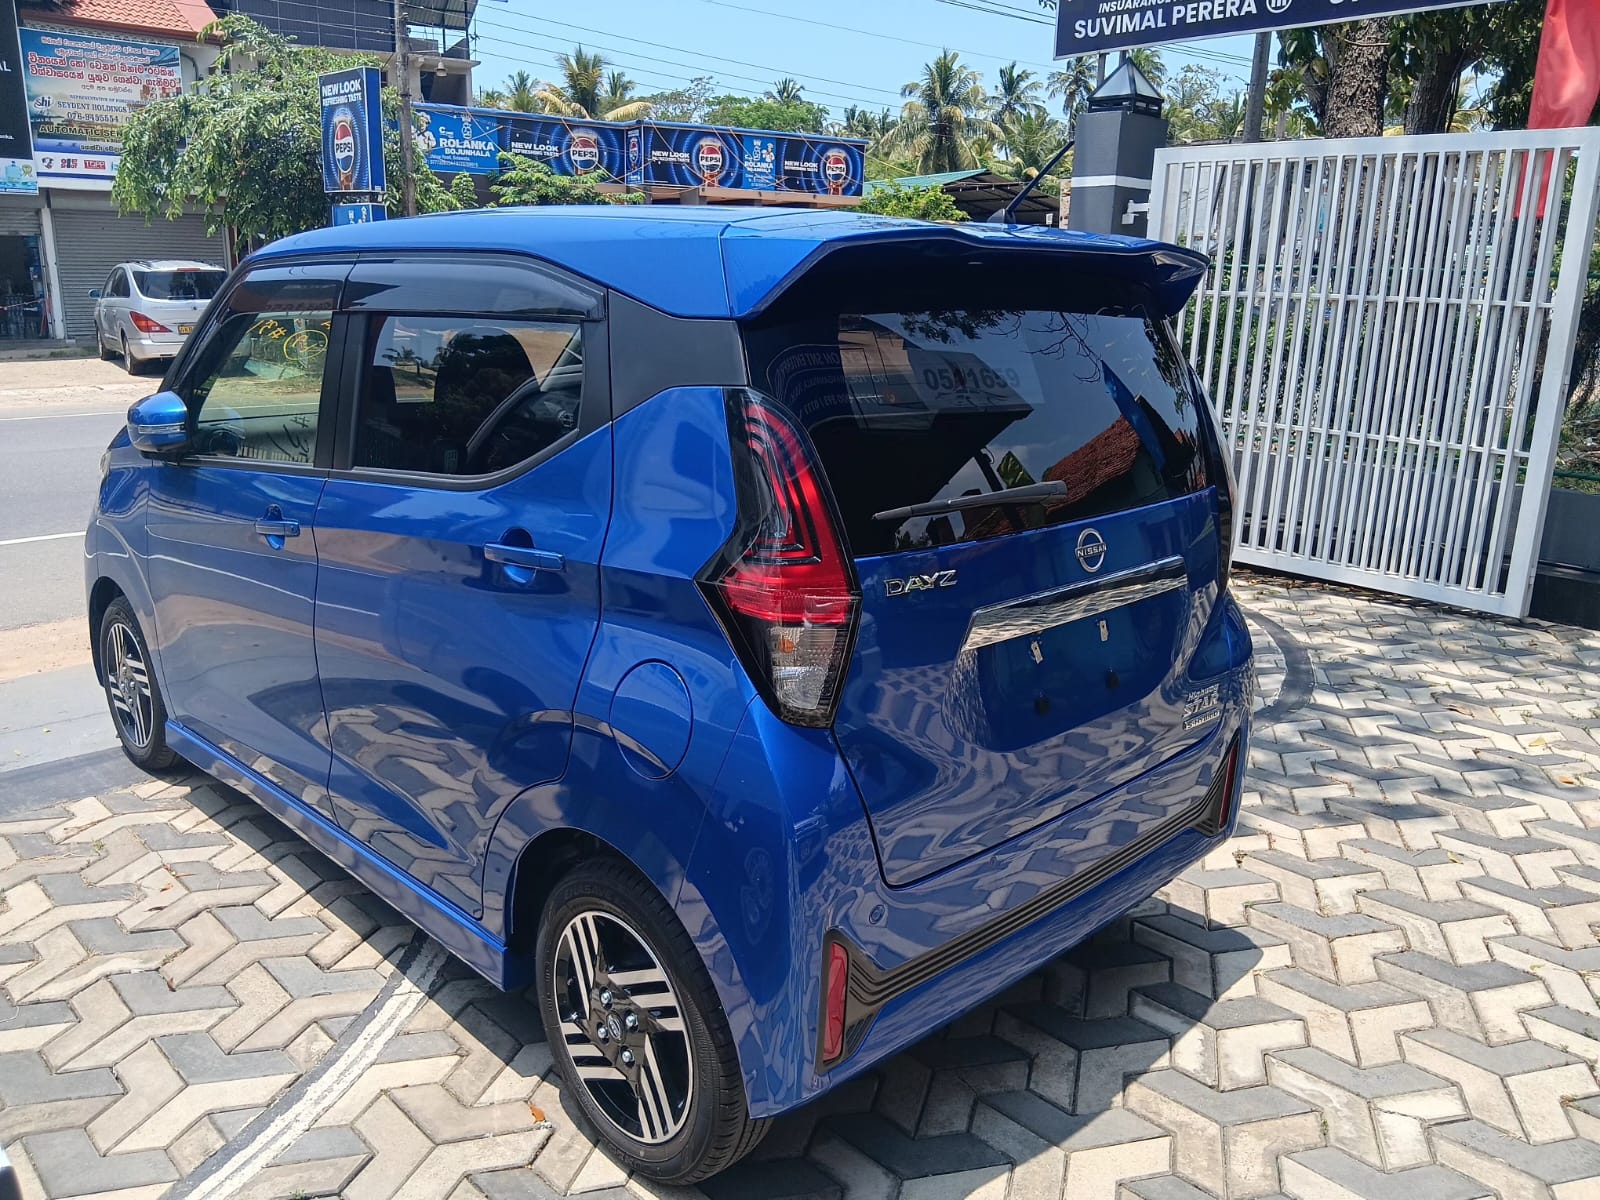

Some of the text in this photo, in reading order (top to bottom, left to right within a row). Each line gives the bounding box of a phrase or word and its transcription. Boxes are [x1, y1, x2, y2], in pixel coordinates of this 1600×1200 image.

[1098, 0, 1177, 13] INSUARAN
[1073, 0, 1257, 39] SUVIMAL PERERA
[322, 79, 361, 97] NEW LOOK
[92, 103, 127, 113] HOLDINGS
[39, 124, 123, 137] AUTOMATIC SEN
[335, 143, 353, 153] PEPSI
[440, 138, 495, 151] ROLANKA
[511, 141, 559, 151] NEW LOOK
[445, 148, 490, 157] BOJUNHALA
[572, 150, 597, 158] PEPSI
[1076, 544, 1107, 558] NISSAN
[884, 570, 957, 596] DAYZ
